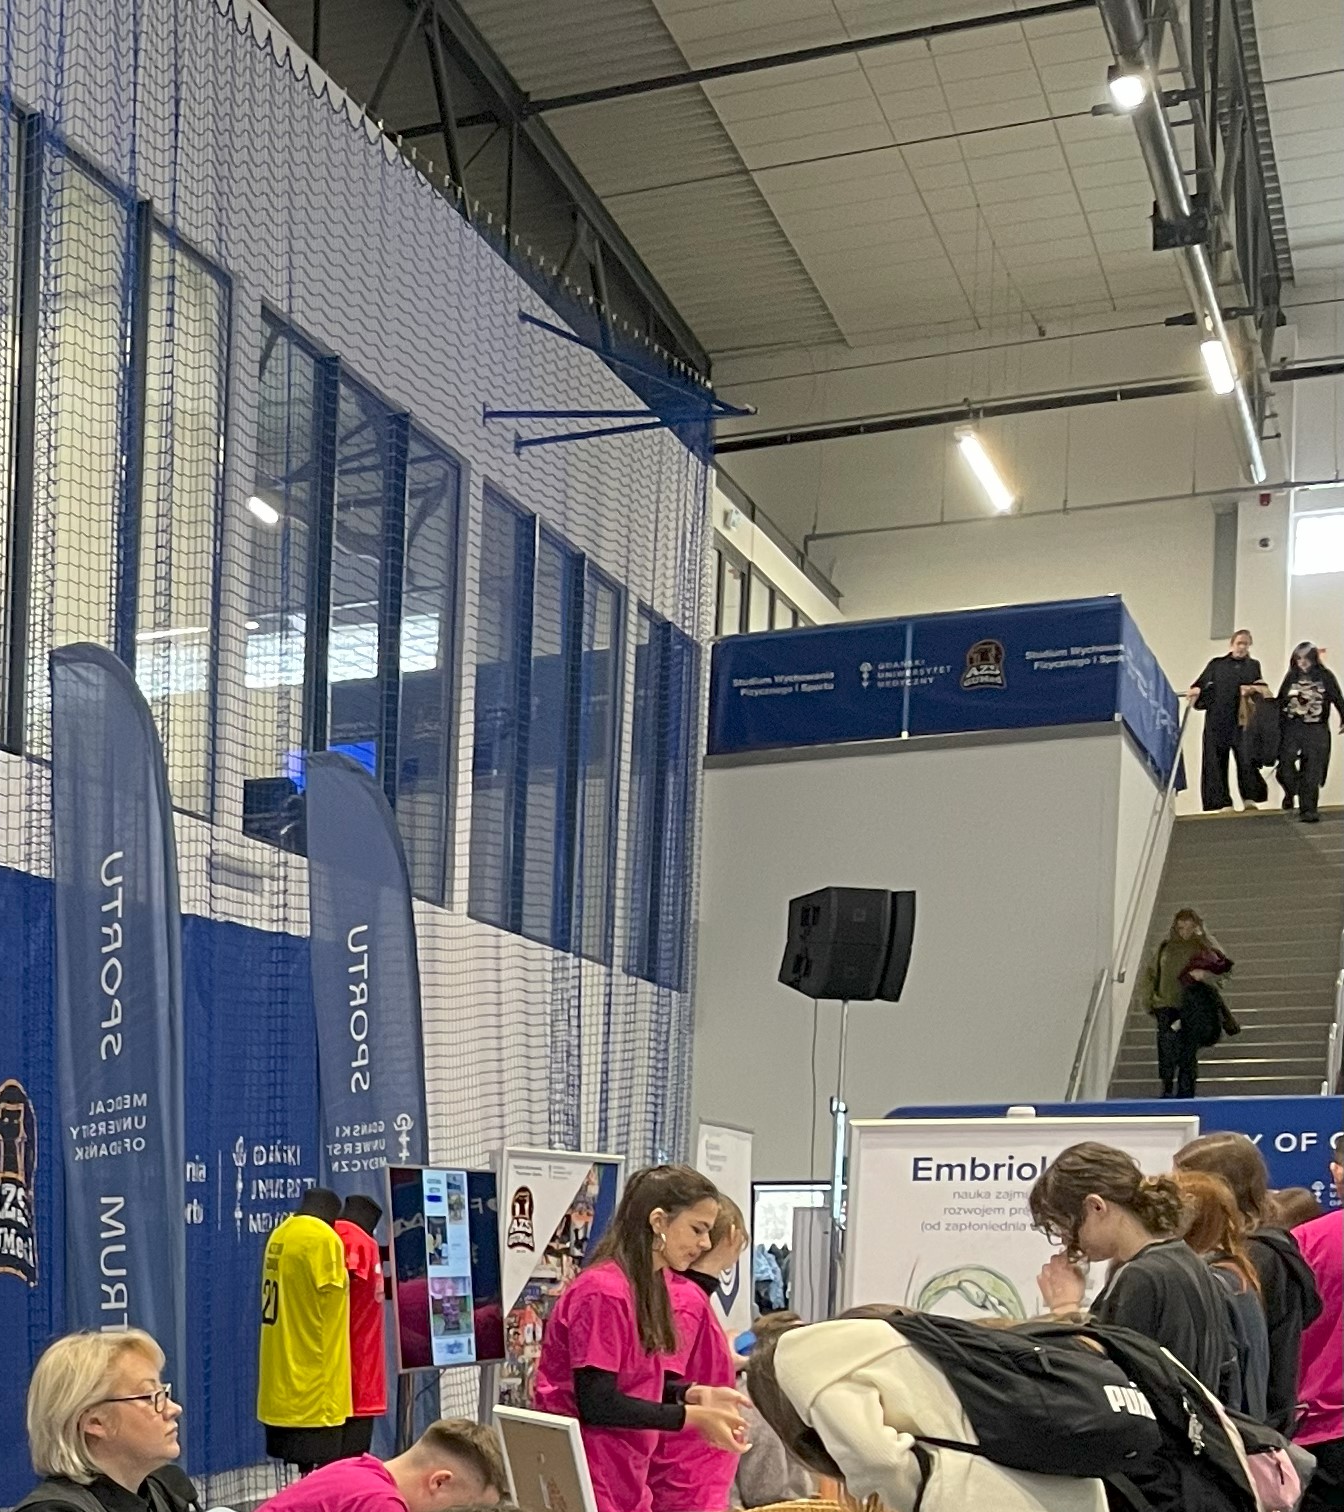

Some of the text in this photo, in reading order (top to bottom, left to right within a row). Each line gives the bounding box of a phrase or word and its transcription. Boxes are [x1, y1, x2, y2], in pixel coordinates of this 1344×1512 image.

[1274, 1132, 1318, 1153] OF
[953, 1190, 992, 1200] nauka
[943, 1205, 1006, 1218] rozwojem
